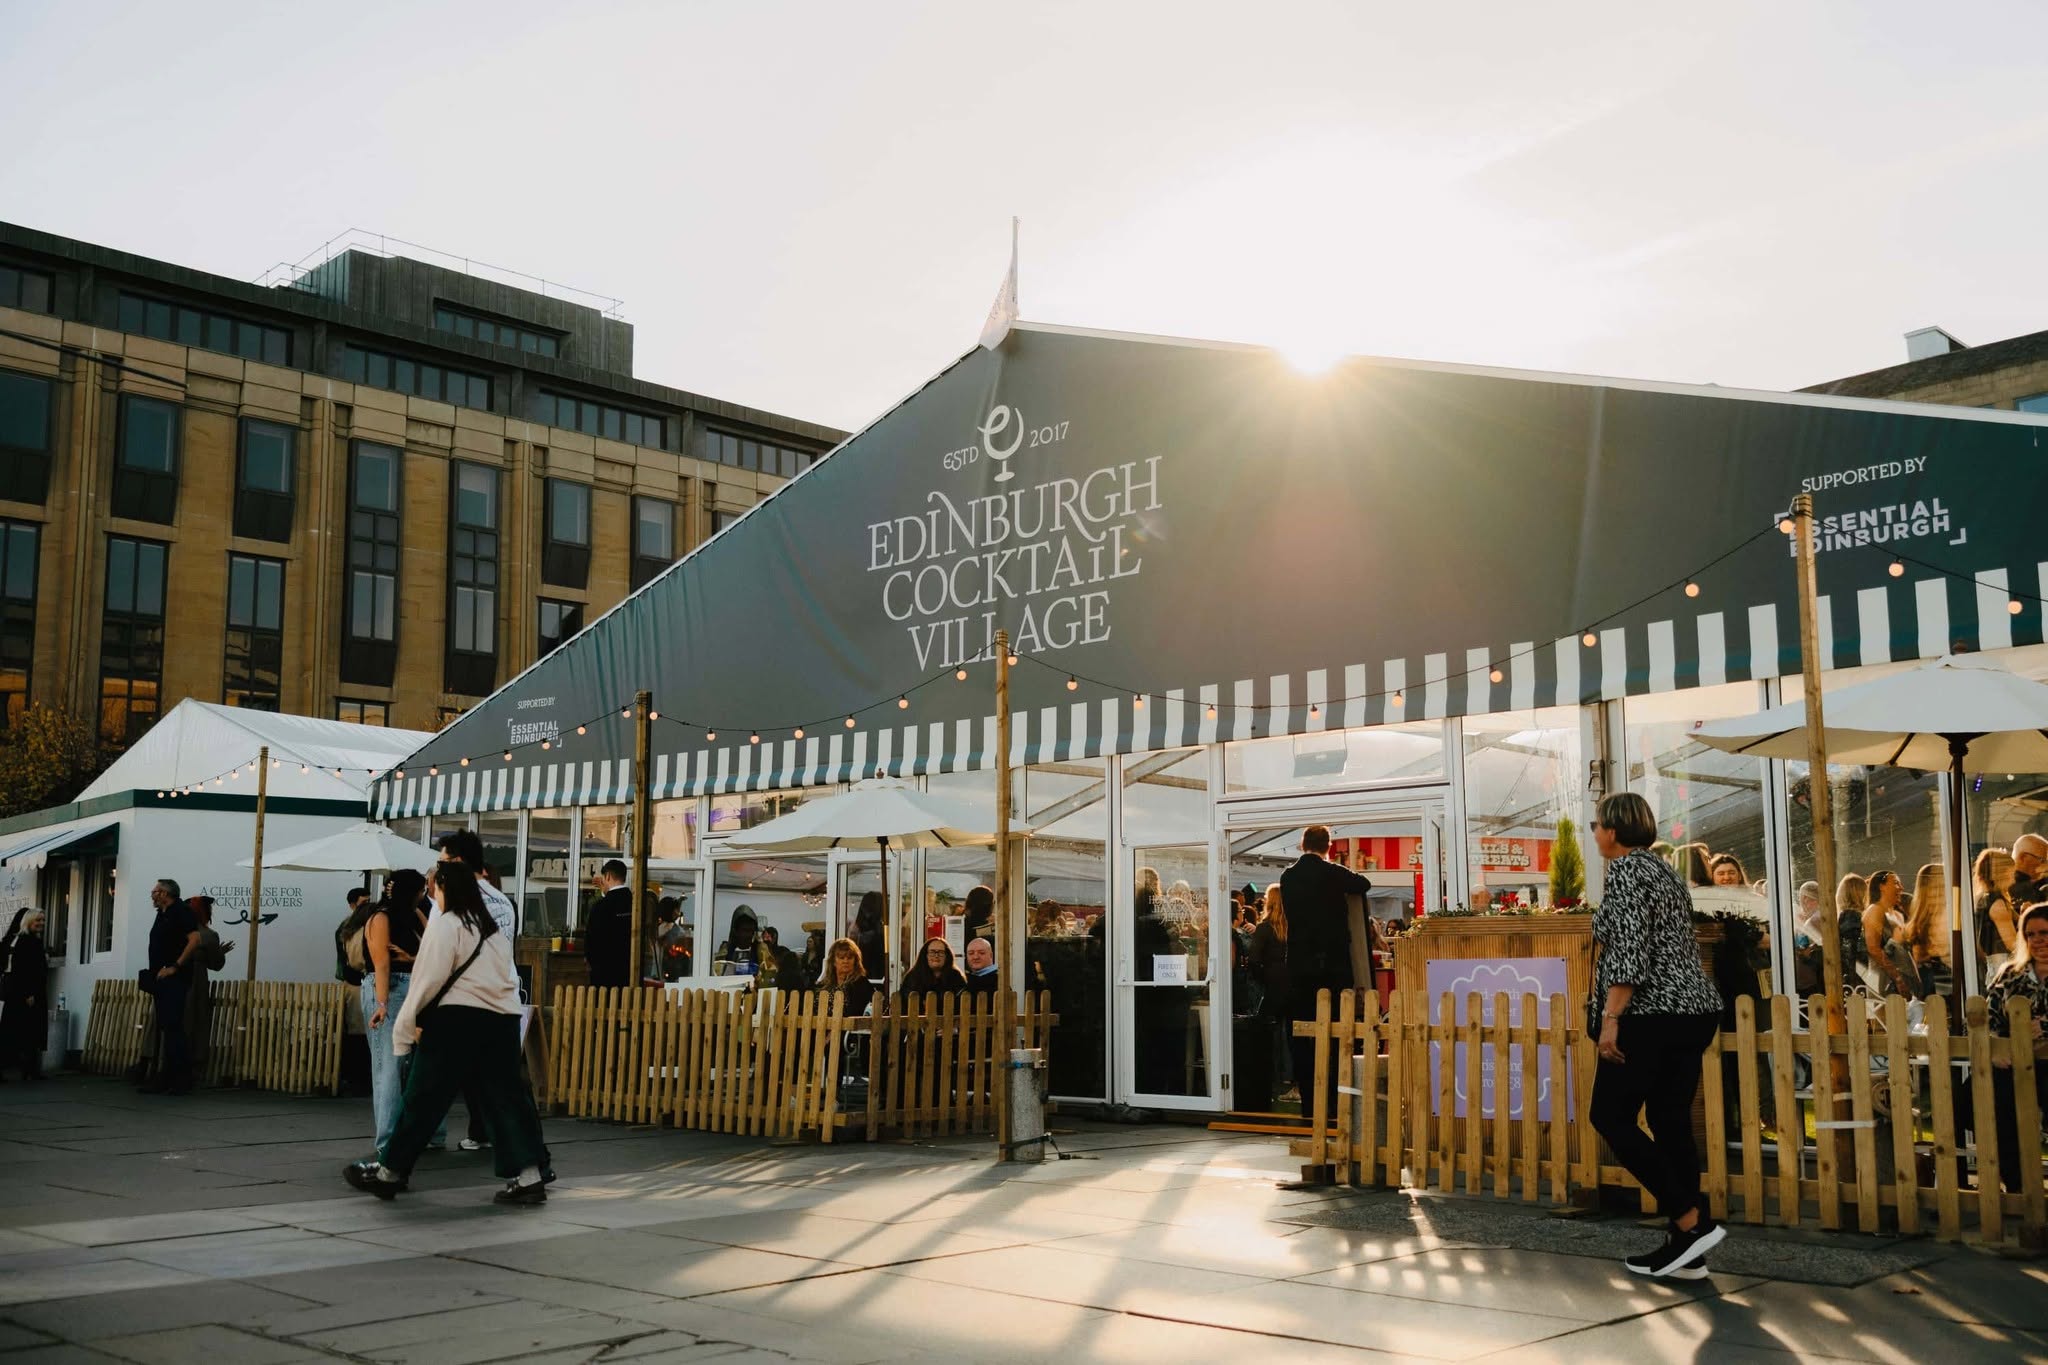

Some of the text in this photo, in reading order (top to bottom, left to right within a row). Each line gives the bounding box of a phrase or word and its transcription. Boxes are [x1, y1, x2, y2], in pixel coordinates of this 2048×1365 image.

[1029, 421, 1069, 448] 2017
[943, 446, 979, 471] ESTD
[1801, 456, 1928, 493] SUPPORTED BY
[867, 455, 1163, 572] EDINBURGH
[1789, 498, 1949, 541] SSENTIAL
[883, 524, 1142, 621] COCKTAIL
[908, 590, 1112, 672] VILLAGE
[517, 698, 548, 710] SUPPORTED
[510, 730, 559, 745] EDINBURGH
[511, 720, 559, 735] ESSENTIAL
[199, 886, 303, 897] A CLUBHSE FOR
[214, 896, 303, 910] CKTAI LOVERS
